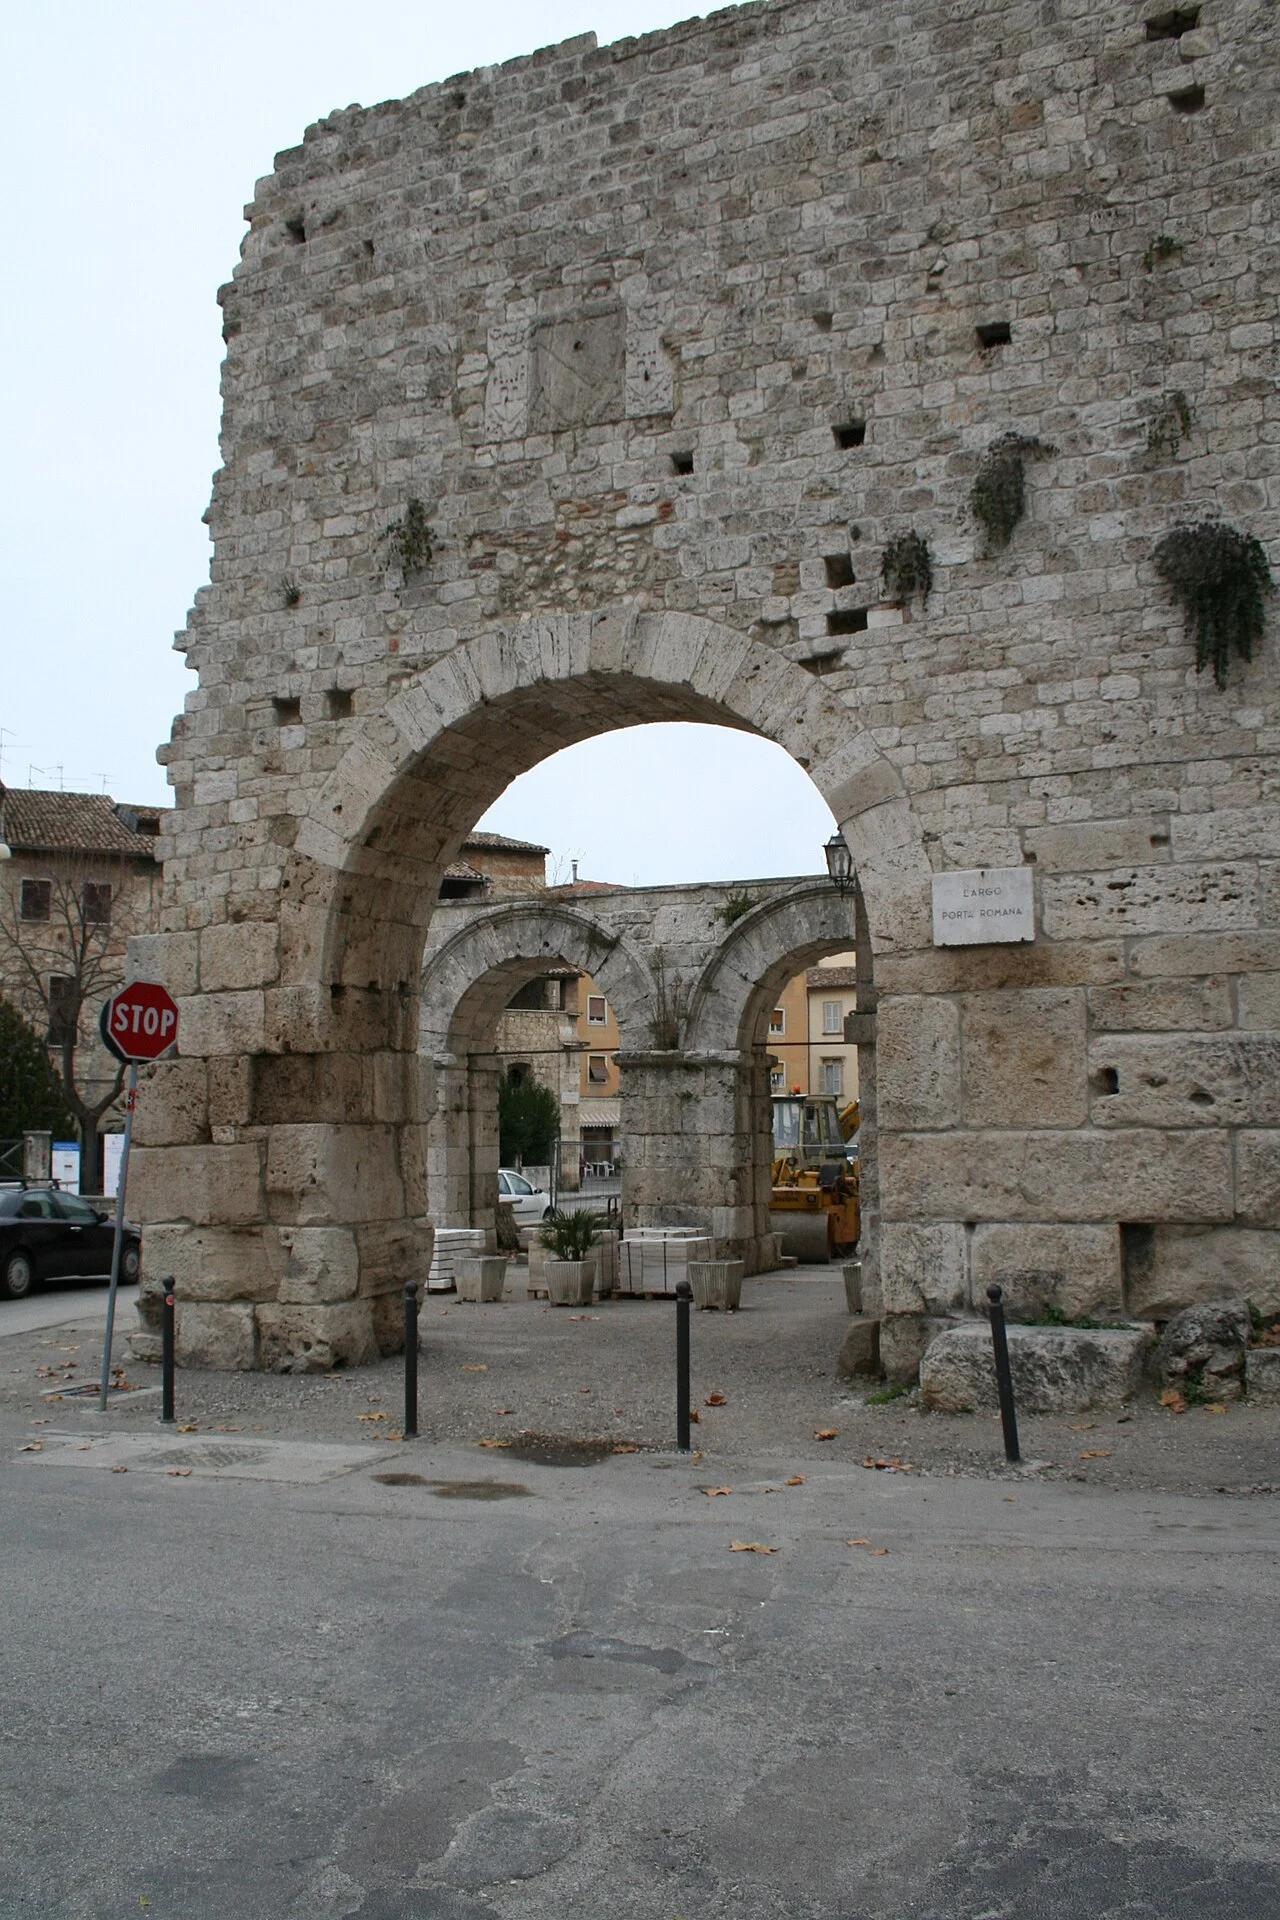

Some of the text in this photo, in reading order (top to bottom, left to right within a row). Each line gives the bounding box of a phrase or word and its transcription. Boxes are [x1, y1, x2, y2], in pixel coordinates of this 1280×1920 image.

[963, 887, 1002, 897] LARGO
[942, 908, 1023, 920] PORTA ROMANA
[114, 1003, 175, 1037] STOP
